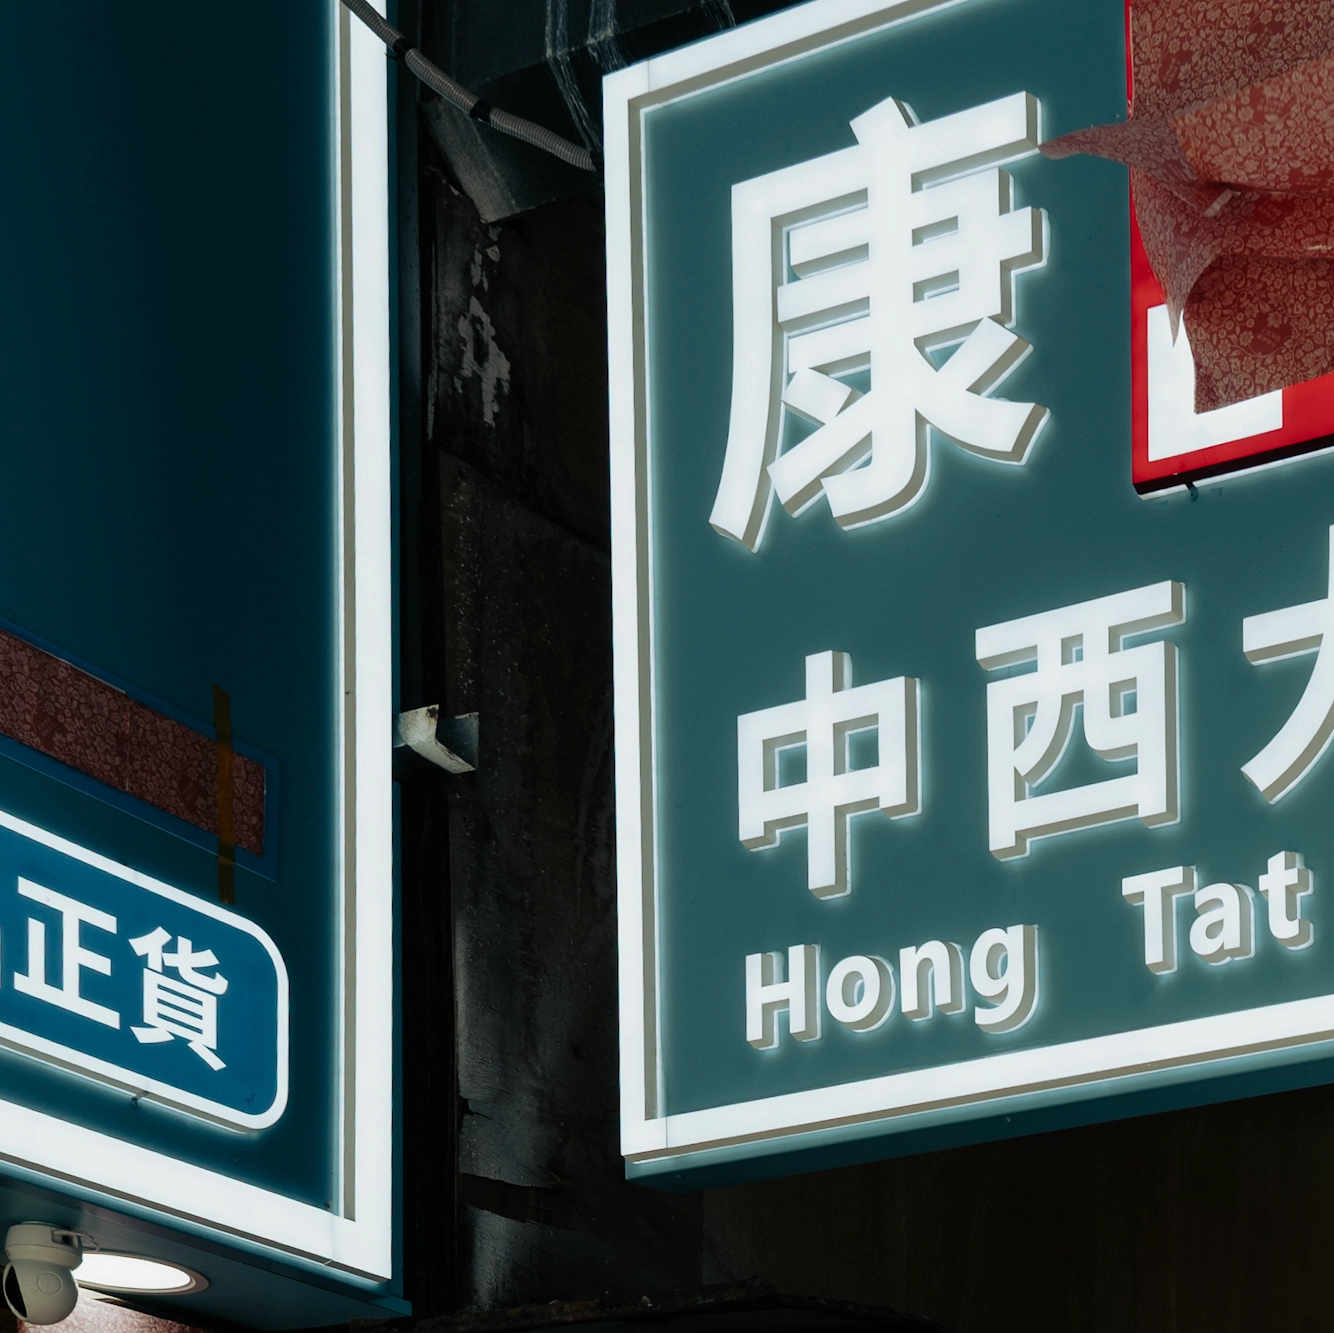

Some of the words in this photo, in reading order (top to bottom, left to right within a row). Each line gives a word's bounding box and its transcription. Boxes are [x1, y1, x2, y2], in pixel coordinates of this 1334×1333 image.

[709, 96, 1049, 553] 康
[12, 875, 229, 1074] 正貨
[745, 923, 1039, 1051] Hong
[1122, 851, 1313, 974] Tat
